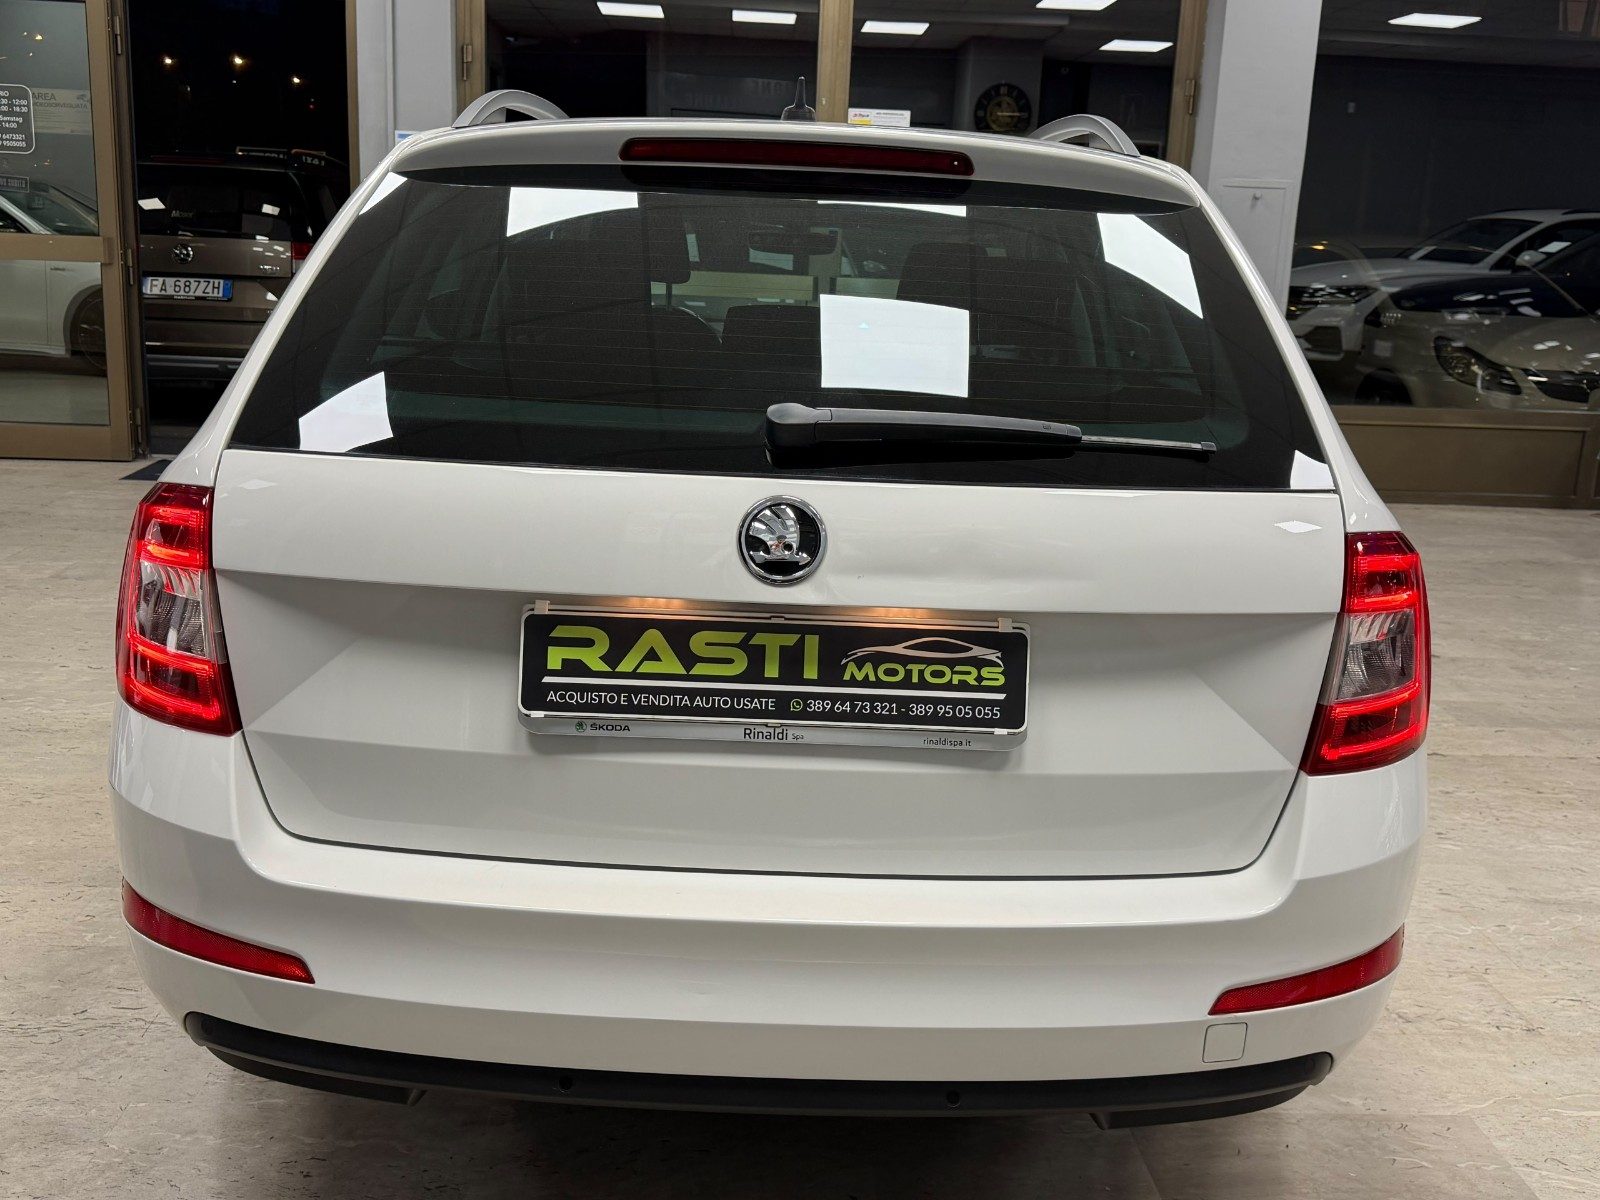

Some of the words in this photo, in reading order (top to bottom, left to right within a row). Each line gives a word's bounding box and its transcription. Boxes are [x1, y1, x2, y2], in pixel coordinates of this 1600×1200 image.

[12, 98, 28, 106] 12:00
[13, 105, 28, 113] 18:30
[2, 121, 17, 129] 14:00
[2, 133, 25, 141] 6473321
[2, 140, 26, 148] 9505055
[149, 278, 168, 294] FA
[173, 279, 221, 296] 687ZH
[546, 624, 820, 680] RASTI
[842, 661, 1006, 687] MOTORS
[546, 690, 618, 705] ACQUISTO
[620, 693, 629, 705] E
[631, 693, 691, 707] VENDITA
[692, 695, 731, 709] AUTO
[734, 697, 776, 711] USATE
[806, 699, 832, 712] 389
[834, 700, 851, 713] 64
[854, 701, 870, 714] 73
[873, 702, 898, 715] 321
[908, 703, 934, 717] 389
[937, 704, 953, 718] 95
[956, 705, 972, 718] 05
[975, 706, 1001, 719] 055
[589, 720, 631, 732] ŠKODA
[743, 727, 788, 741] Rinaldi
[791, 732, 804, 741] Spa
